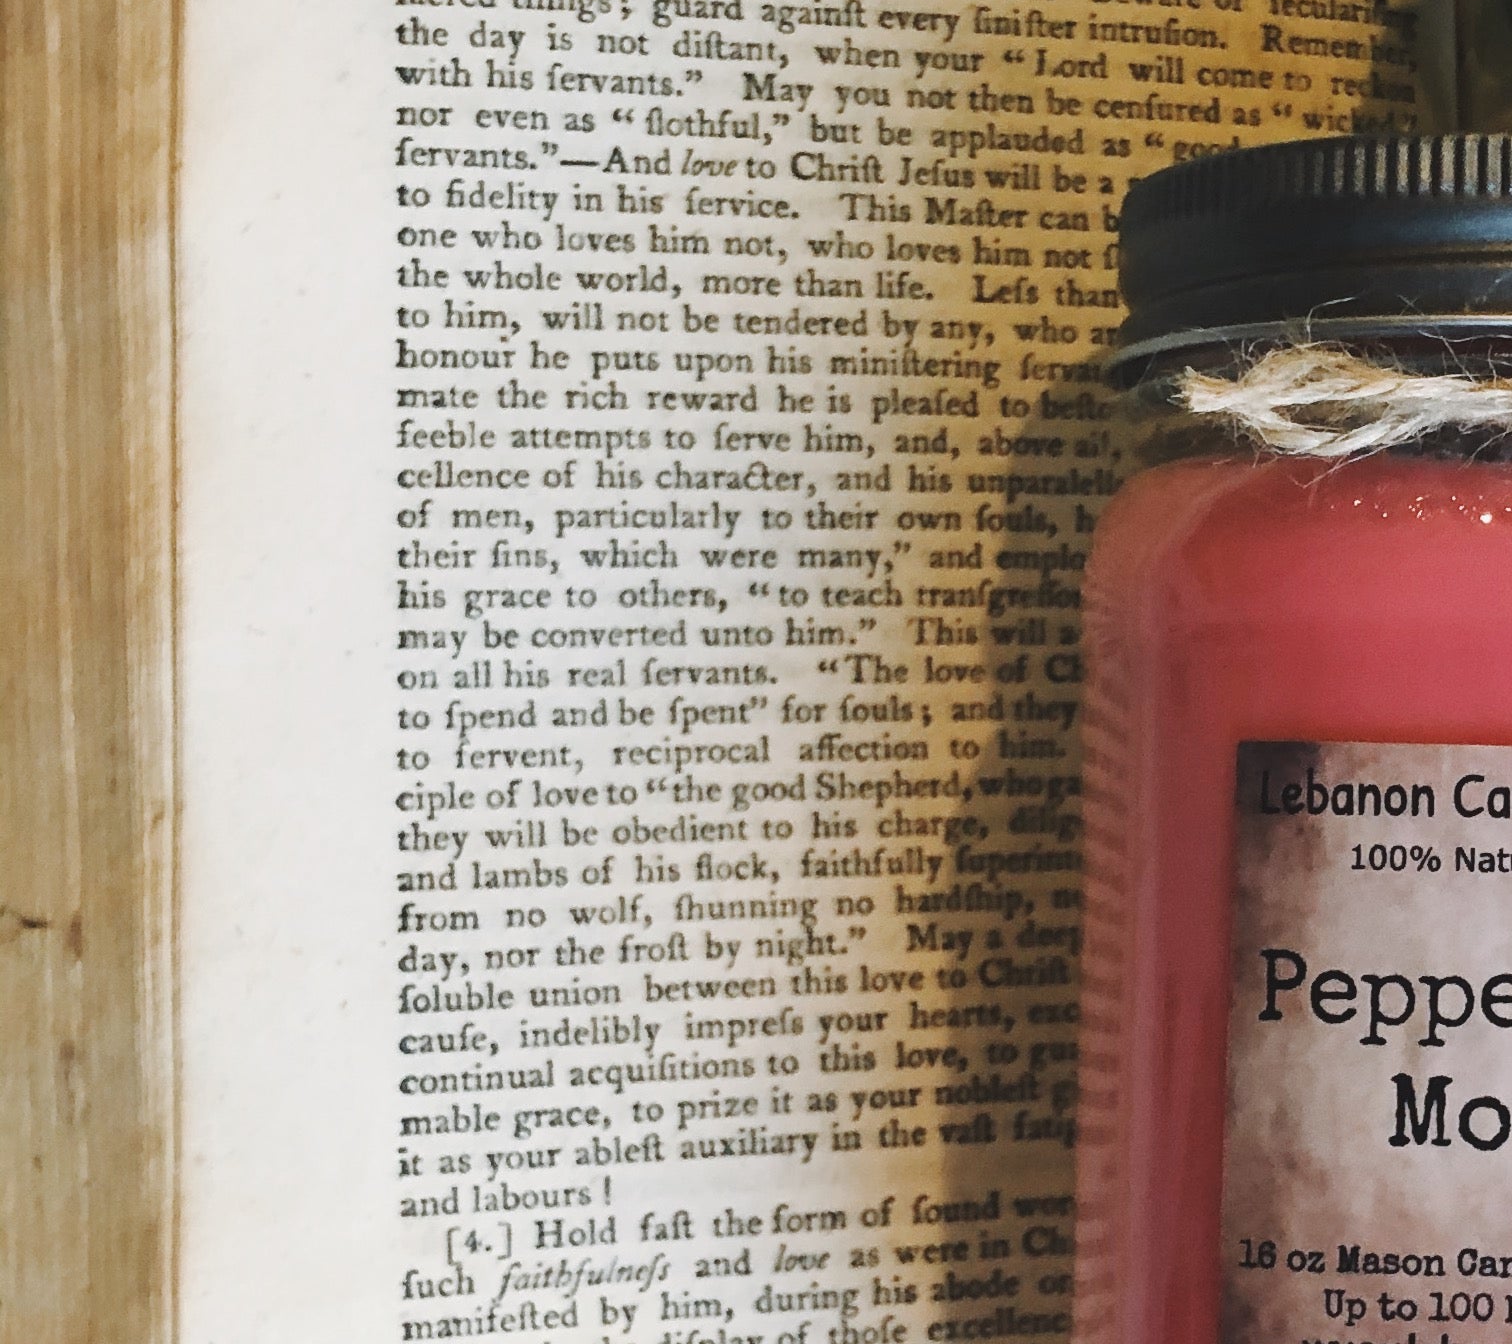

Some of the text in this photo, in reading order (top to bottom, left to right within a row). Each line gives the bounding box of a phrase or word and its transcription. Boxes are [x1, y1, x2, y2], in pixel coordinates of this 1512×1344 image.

[395, 260, 450, 289] the
[462, 260, 562, 291] whole
[575, 264, 682, 300] world,
[701, 274, 782, 298] more
[793, 267, 864, 299] than
[875, 270, 935, 301] life.
[1054, 279, 1119, 309] than
[395, 298, 1078, 352] to him, will not be tendered by any, who
[396, 629, 467, 660] may
[482, 619, 520, 650] be
[530, 619, 688, 649] converted
[699, 625, 774, 647] unto
[908, 616, 979, 646] This
[989, 618, 1046, 646] will
[1258, 764, 1436, 818] Lebanon
[396, 808, 989, 861] they will be obedient to his charge,
[1350, 843, 1442, 873] 100%
[399, 1186, 460, 1218] and
[1238, 1238, 1277, 1270] 16
[1286, 1248, 1326, 1275] oz
[1335, 1244, 1447, 1278] Mason
[1323, 1288, 1367, 1327] Up
[1376, 1291, 1418, 1322] to
[1427, 1291, 1495, 1323] 100
